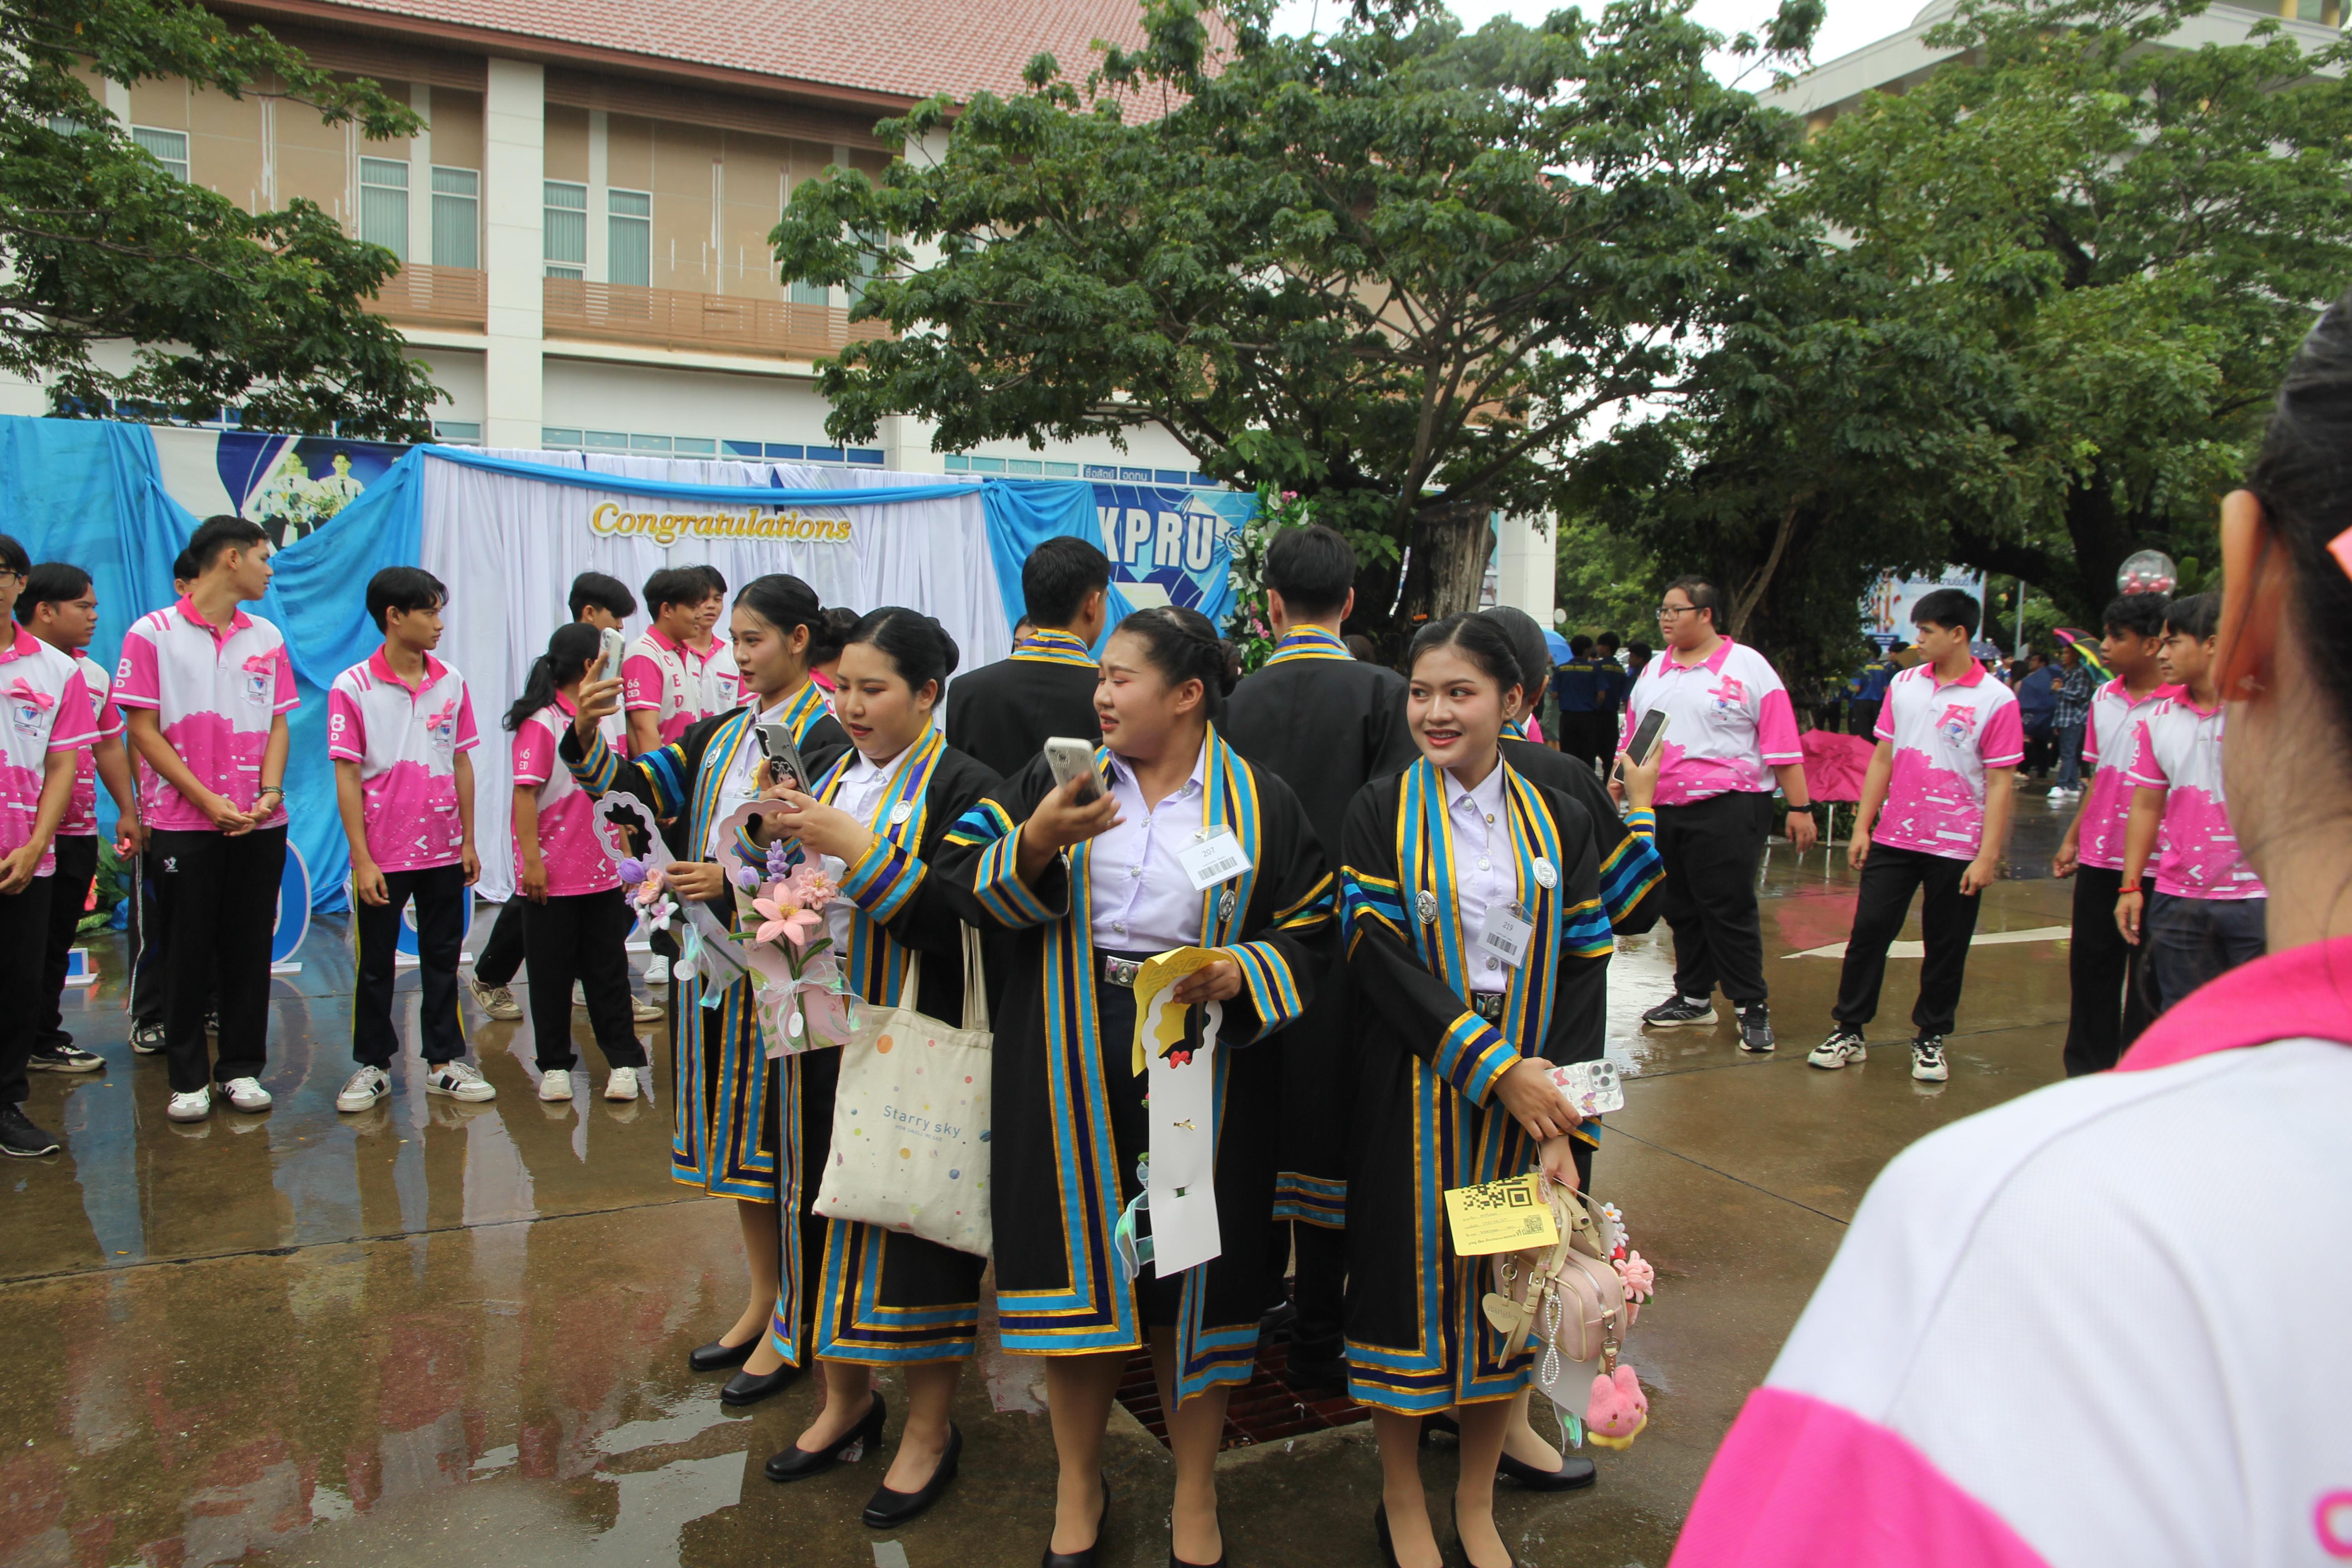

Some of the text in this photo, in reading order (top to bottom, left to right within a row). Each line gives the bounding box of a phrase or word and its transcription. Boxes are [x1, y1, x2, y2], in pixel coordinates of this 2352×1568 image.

[1122, 471, 1148, 481] อดทน
[593, 503, 851, 544] Congratulations
[1097, 506, 1214, 571] KPRU
[627, 678, 640, 689] 66
[627, 689, 641, 698] CED
[1202, 847, 1215, 857] 207
[1503, 921, 1513, 931] 219
[883, 1105, 960, 1138] Starry sky
